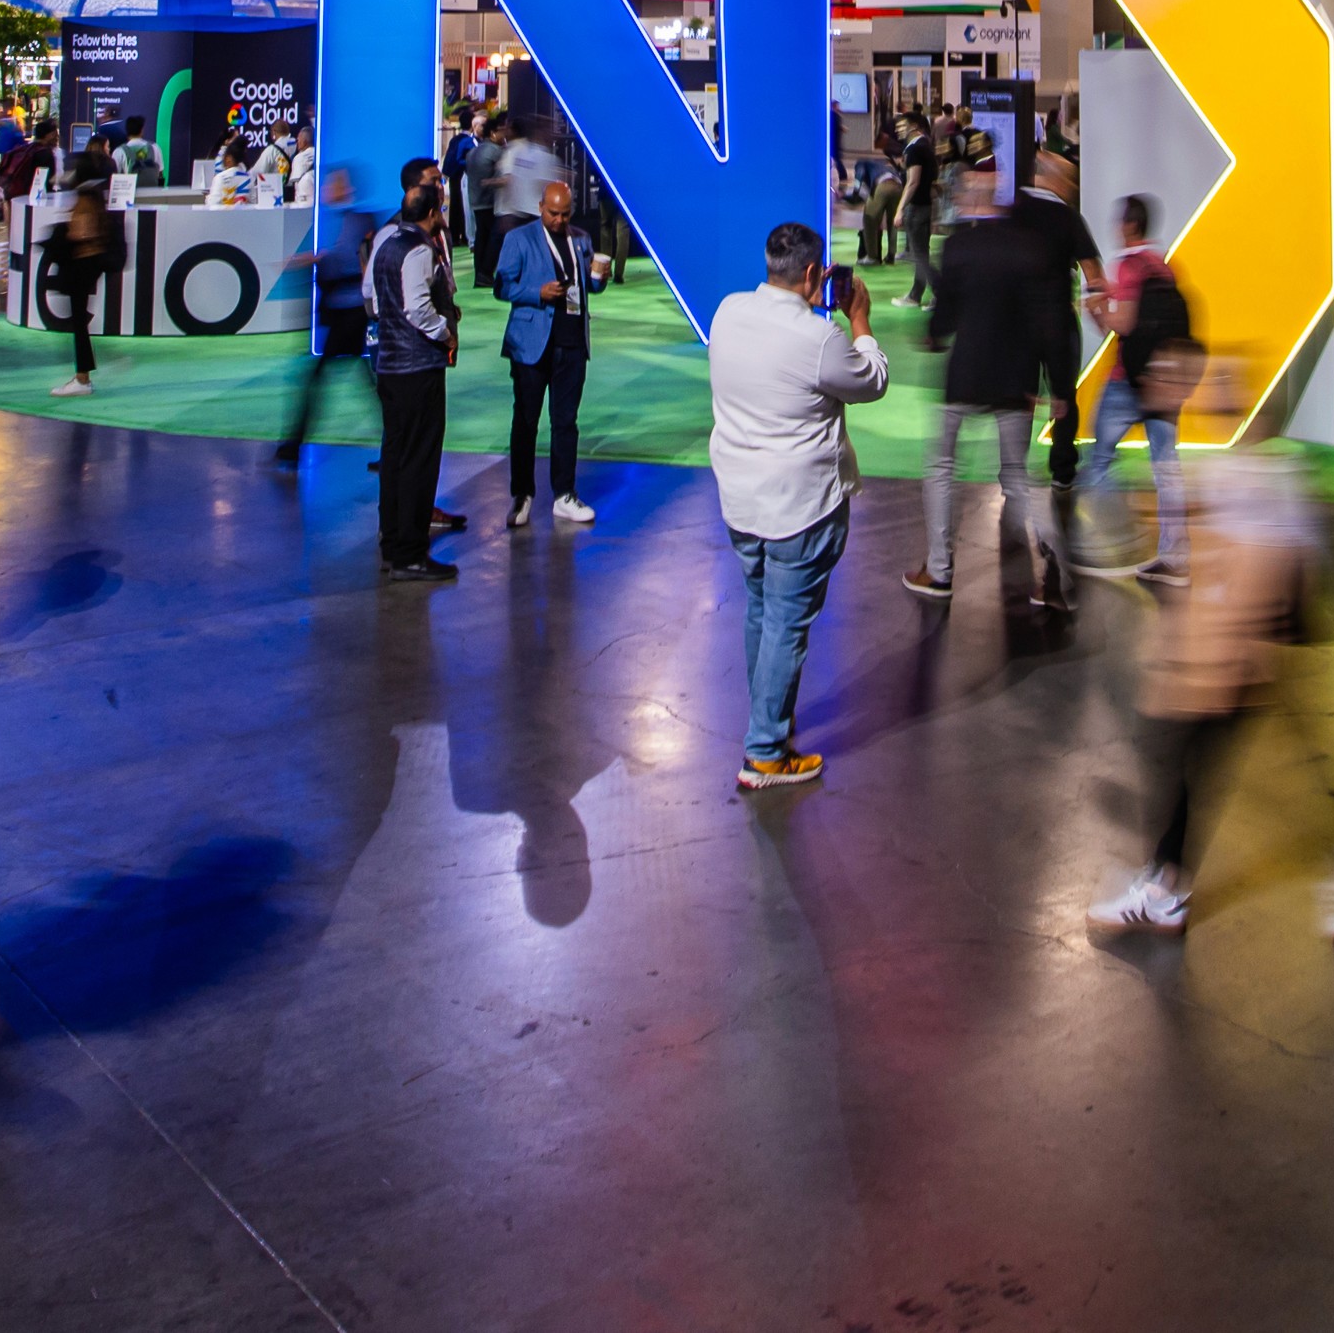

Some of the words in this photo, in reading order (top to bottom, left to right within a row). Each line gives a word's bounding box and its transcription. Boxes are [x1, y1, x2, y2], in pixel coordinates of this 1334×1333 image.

[72, 34, 100, 46] Follow
[101, 33, 116, 46] the
[117, 33, 137, 46] lines
[72, 48, 82, 60] to
[83, 48, 115, 63] explore
[115, 48, 139, 63] Expo
[229, 77, 293, 106] Google
[249, 102, 298, 125] Cloud
[228, 126, 269, 148] ext
